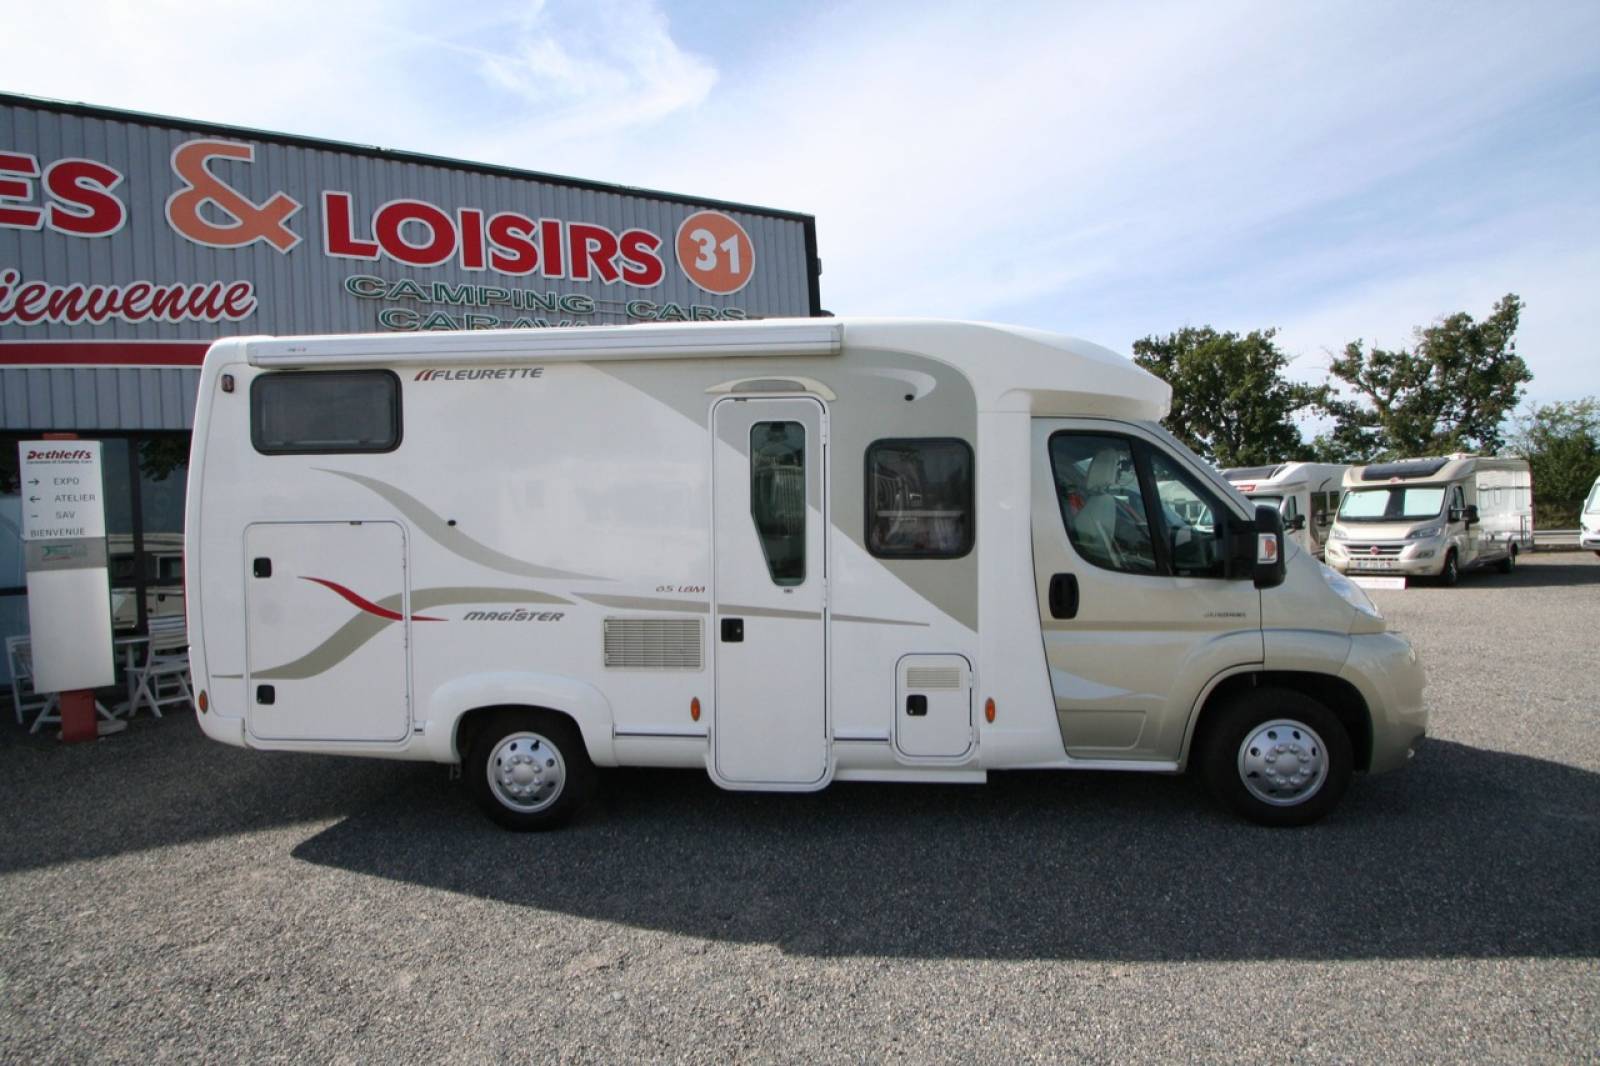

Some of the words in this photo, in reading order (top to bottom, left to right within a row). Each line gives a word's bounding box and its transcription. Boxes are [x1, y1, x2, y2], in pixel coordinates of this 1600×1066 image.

[165, 139, 303, 254] &
[322, 190, 666, 288] LOISIRS
[690, 228, 740, 274] 31
[344, 274, 596, 314] CAMPING
[625, 299, 747, 322] CARS
[430, 366, 545, 382] FLEURETTE
[26, 449, 92, 460] Dethleffs
[53, 476, 80, 486] EXPO
[54, 493, 96, 503] ATELIER
[55, 511, 76, 520] SAV
[30, 527, 87, 538] BIENVENUE
[463, 608, 565, 622] MAGISTER
